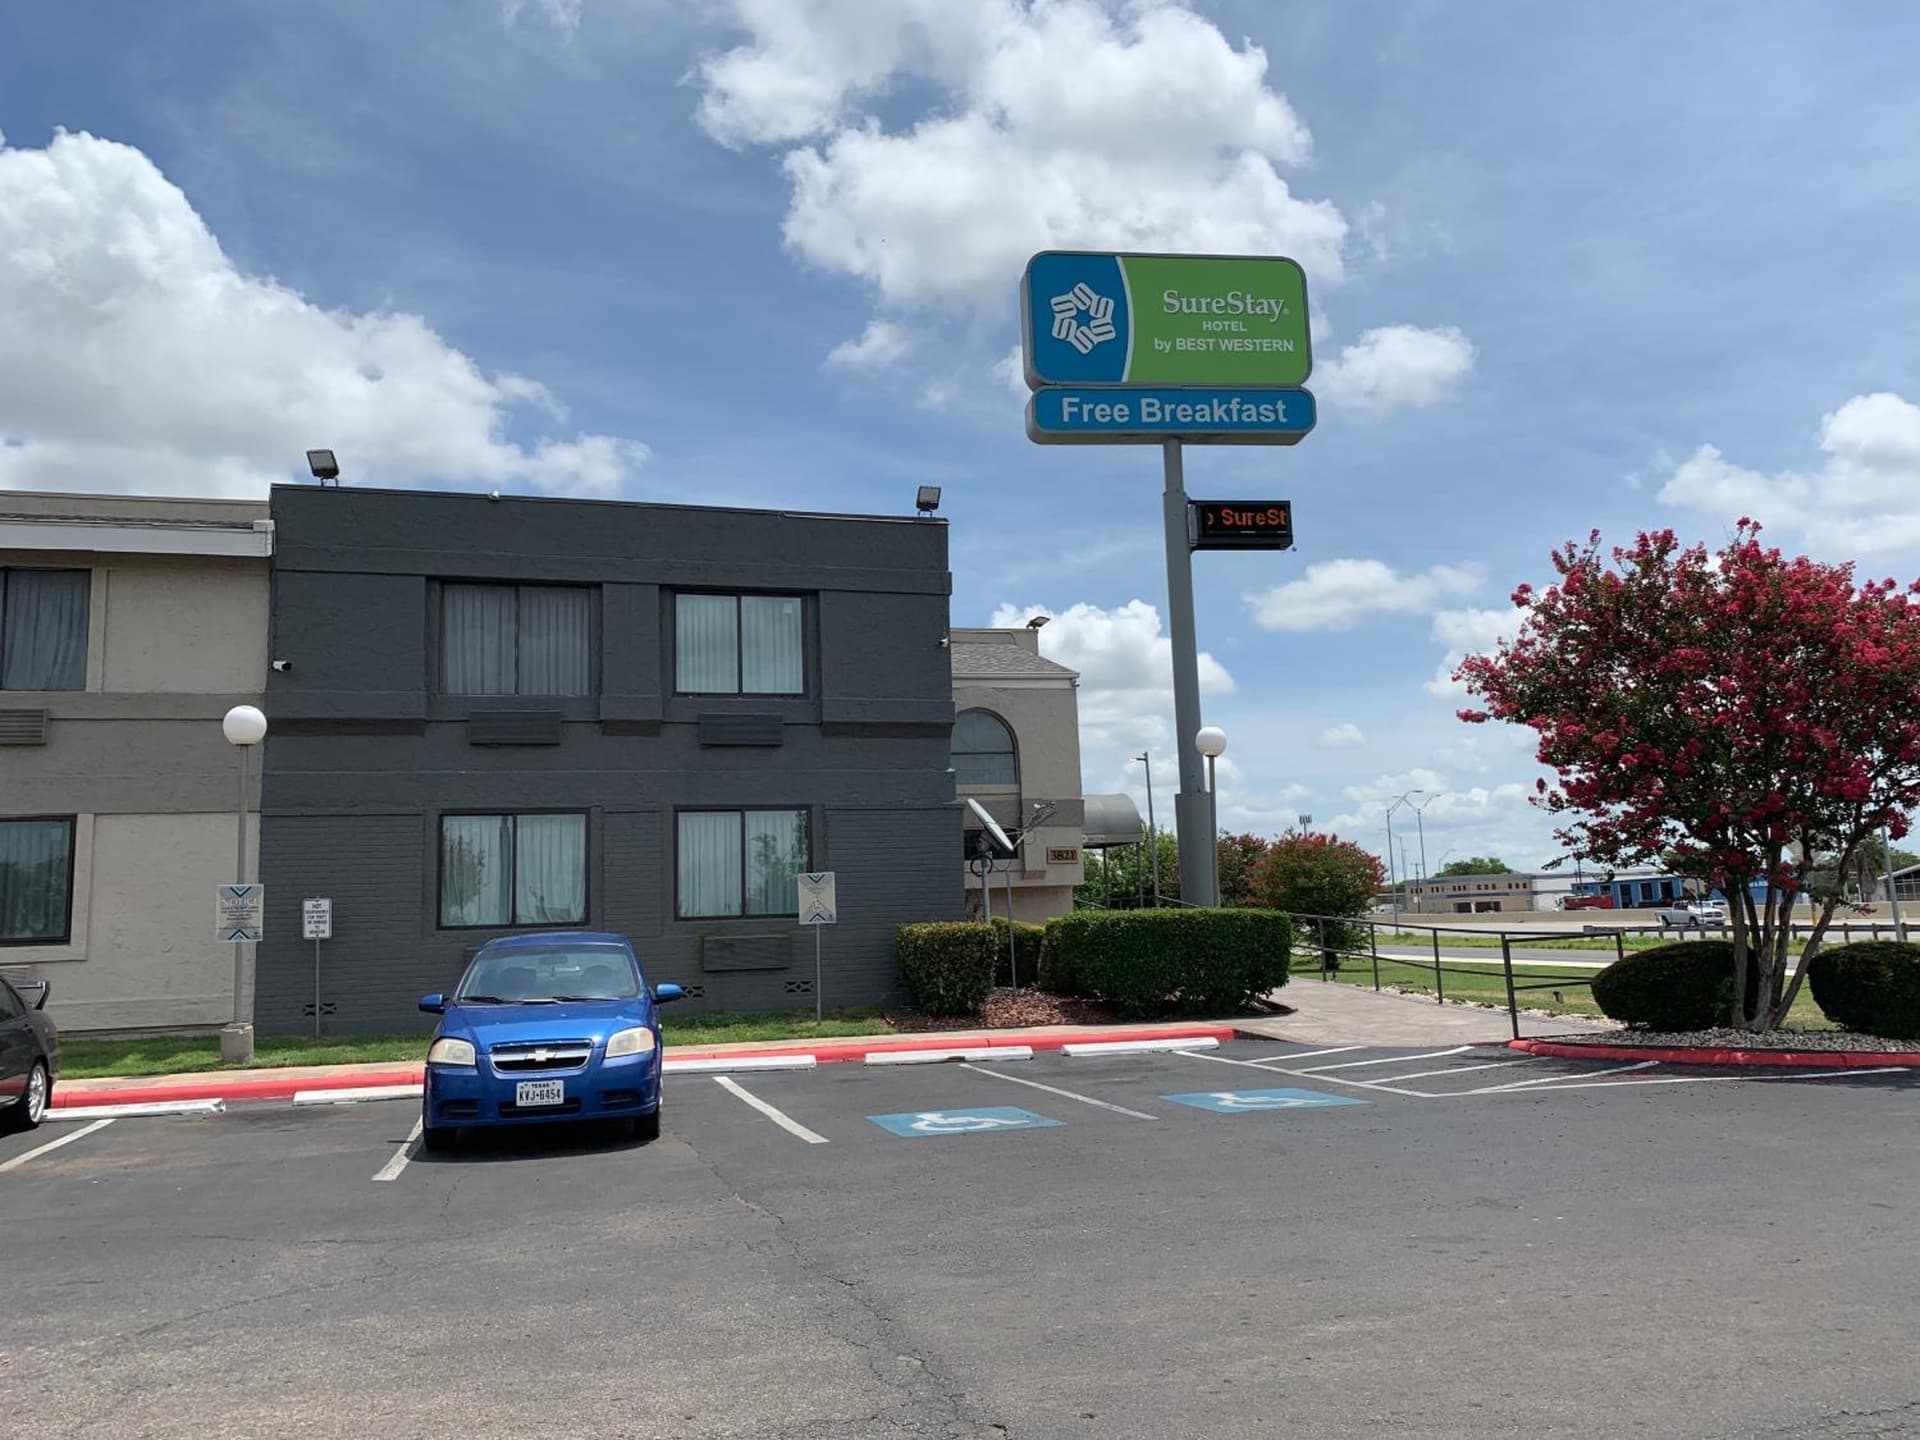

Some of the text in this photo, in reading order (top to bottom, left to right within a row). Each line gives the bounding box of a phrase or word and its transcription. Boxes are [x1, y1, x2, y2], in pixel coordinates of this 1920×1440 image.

[1162, 289, 1285, 323] SureStay
[1202, 321, 1248, 332] HOTEL
[1154, 337, 1294, 353] by BEST WESTERN
[1061, 397, 1288, 424] Free Breakfast
